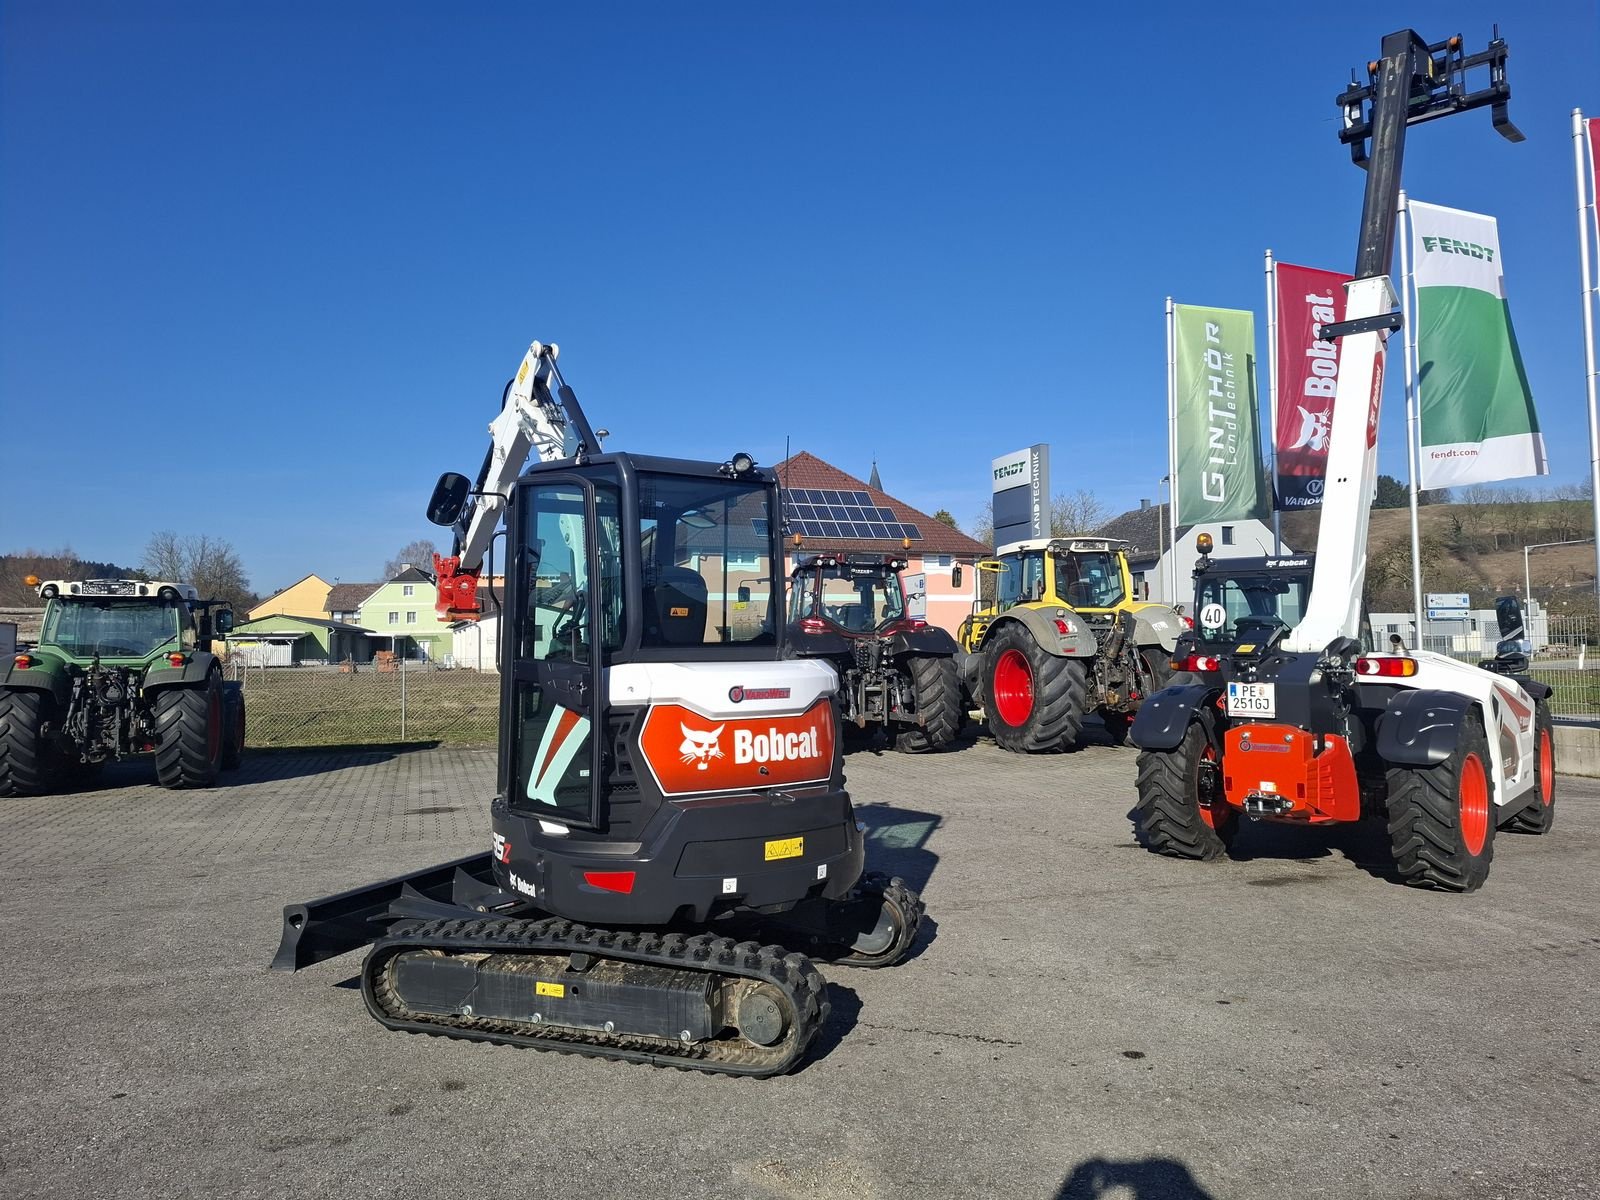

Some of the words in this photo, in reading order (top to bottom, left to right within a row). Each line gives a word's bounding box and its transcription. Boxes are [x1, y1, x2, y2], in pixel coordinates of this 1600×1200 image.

[1422, 237, 1494, 263] FENDT
[1203, 322, 1231, 502] GINTHÖR
[1431, 450, 1478, 459] fendt.com
[993, 461, 1026, 480] FENDT
[1033, 451, 1041, 538] LANDTECHNIK
[1279, 559, 1308, 567] Bobcat
[1205, 608, 1220, 624] 40
[1242, 685, 1256, 697] PE
[1233, 697, 1270, 710] 251GJ
[733, 726, 819, 765] Bobcat
